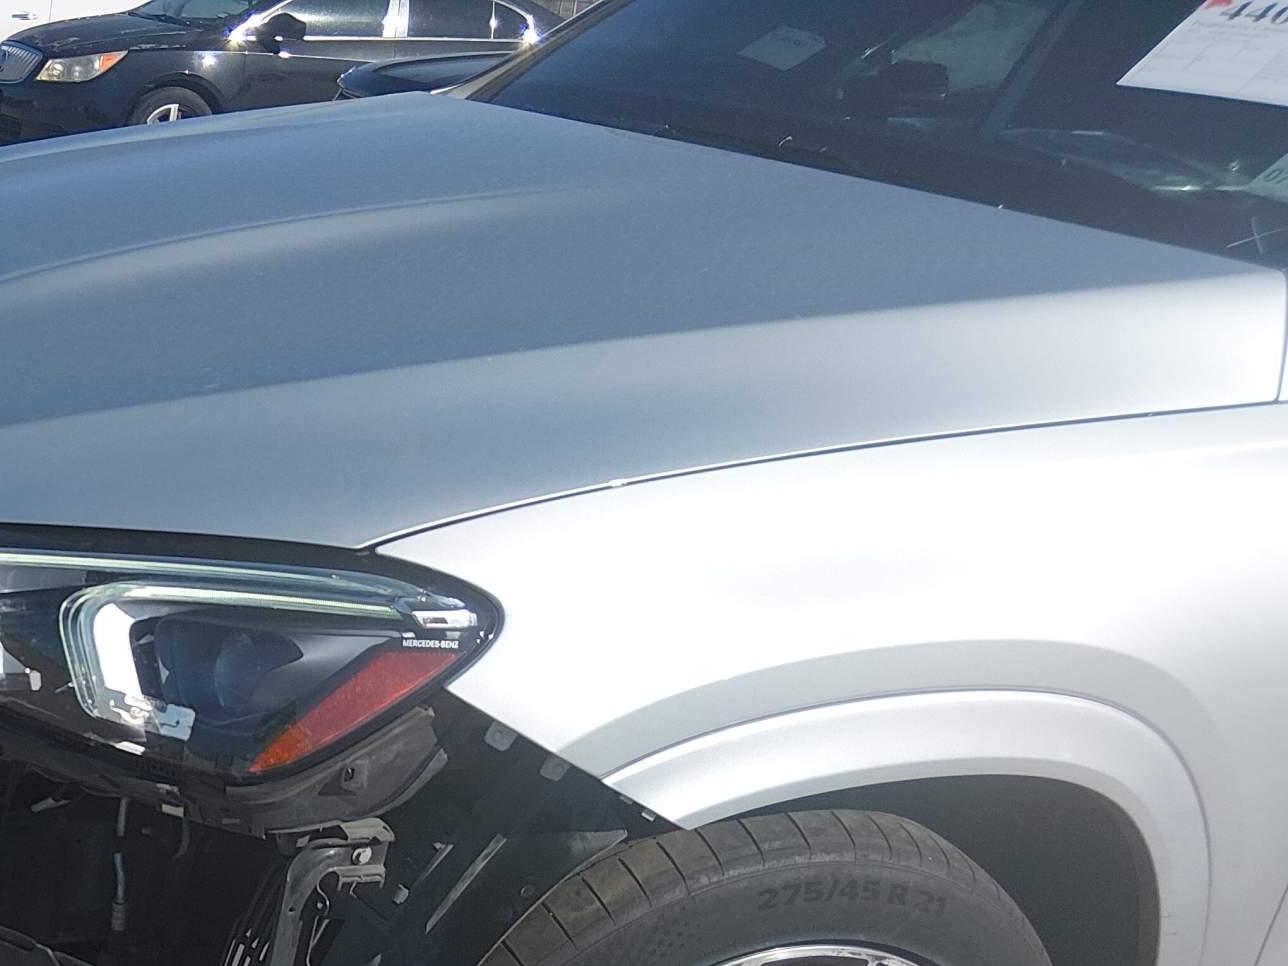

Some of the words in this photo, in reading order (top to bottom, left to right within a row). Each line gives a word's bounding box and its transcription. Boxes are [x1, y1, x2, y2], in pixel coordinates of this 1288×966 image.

[402, 639, 459, 649] MERCEDES-BENZ
[757, 879, 881, 912] 275/45
[889, 882, 909, 906] R
